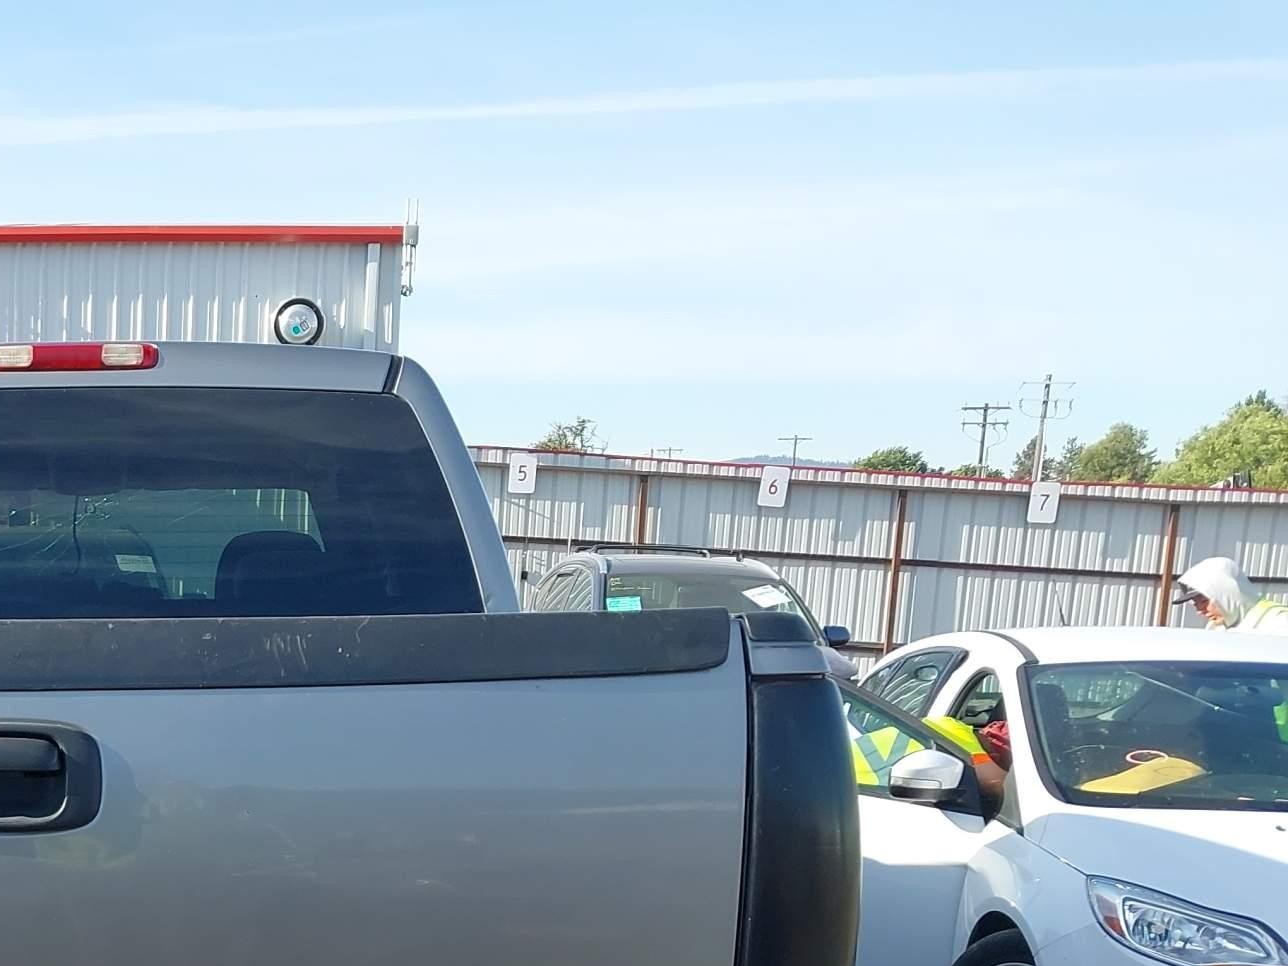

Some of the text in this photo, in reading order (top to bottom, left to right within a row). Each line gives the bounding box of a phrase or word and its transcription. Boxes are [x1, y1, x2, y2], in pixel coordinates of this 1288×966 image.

[517, 464, 528, 482] 5
[768, 478, 779, 495] 6
[1039, 493, 1051, 511] 7
